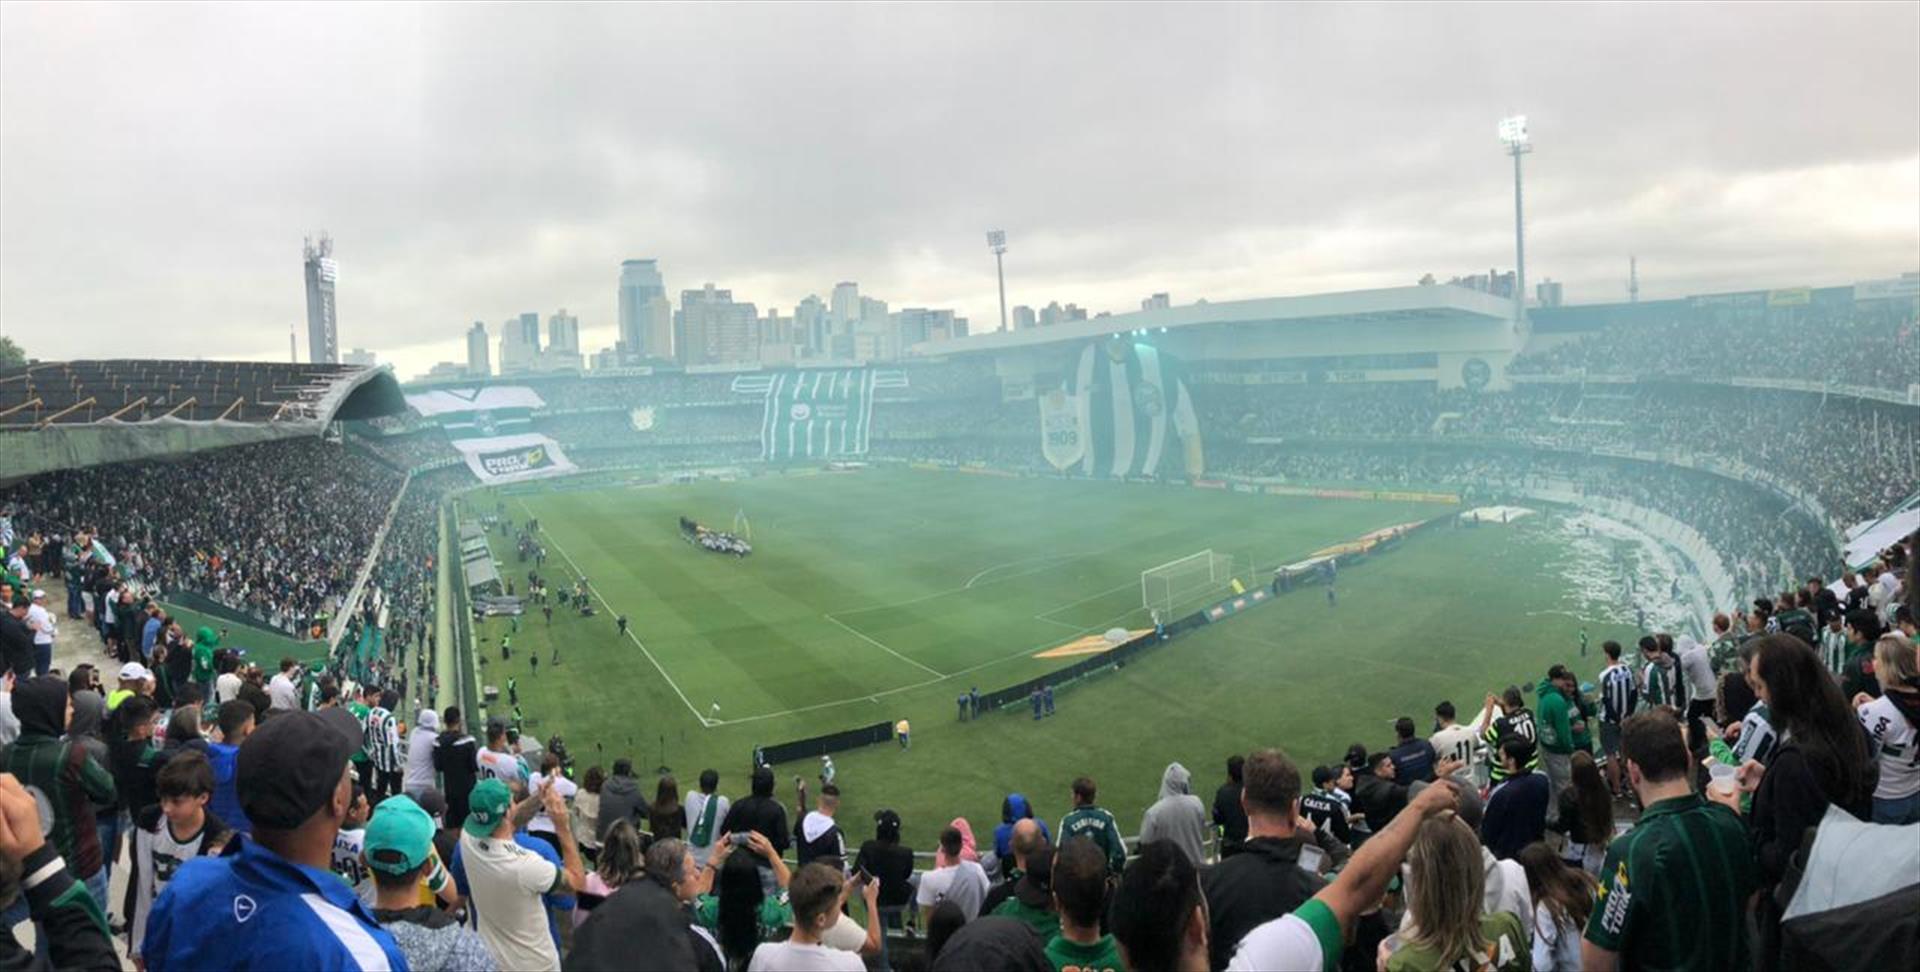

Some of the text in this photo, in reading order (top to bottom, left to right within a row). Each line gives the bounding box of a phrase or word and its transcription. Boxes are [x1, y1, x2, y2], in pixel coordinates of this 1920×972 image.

[1513, 719, 1536, 744] 10
[1456, 740, 1470, 765] 11
[1303, 797, 1331, 812] CAIXA
[1601, 889, 1618, 931] PRO
[1608, 893, 1632, 934] TORK
